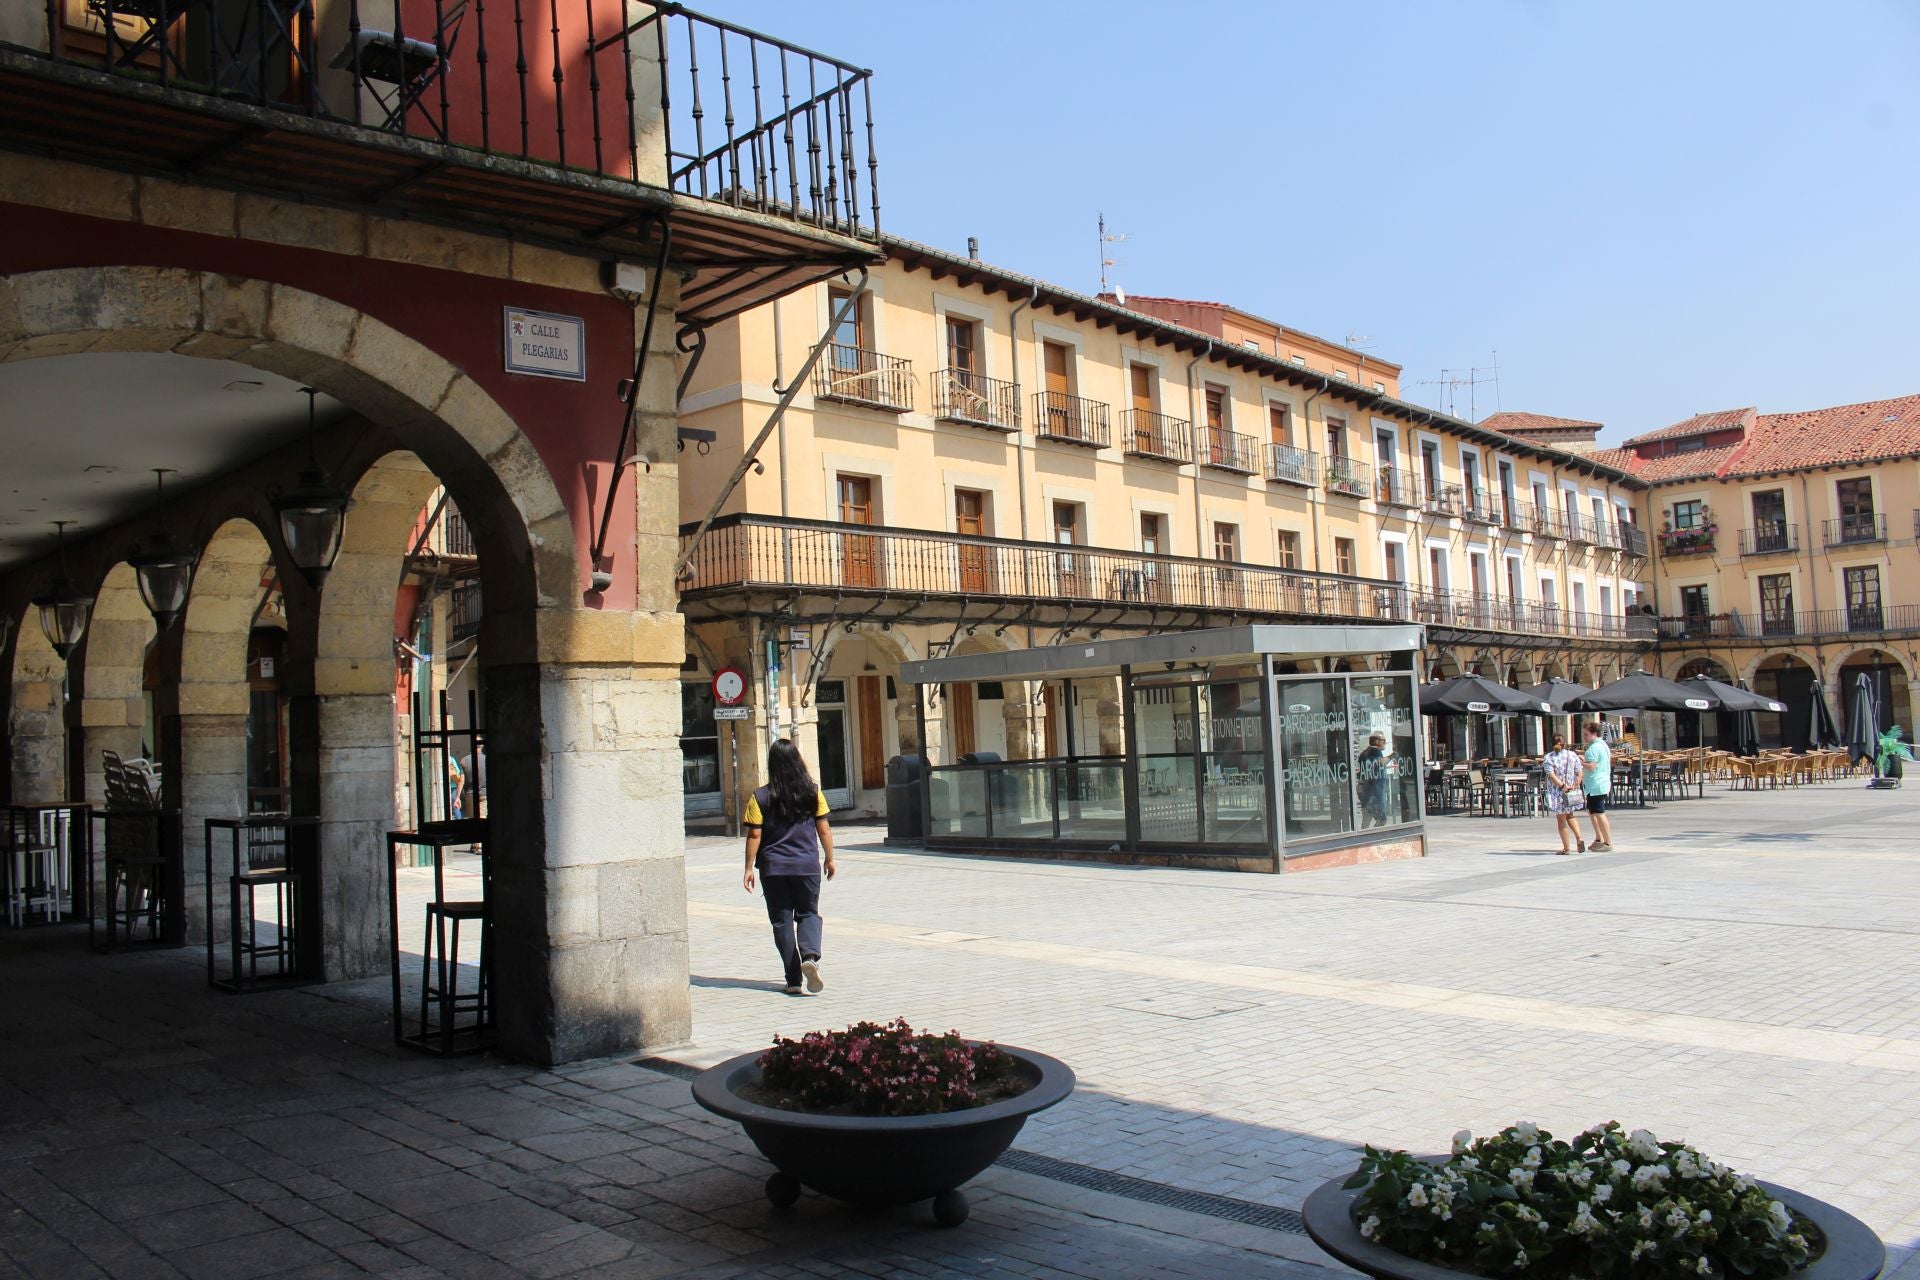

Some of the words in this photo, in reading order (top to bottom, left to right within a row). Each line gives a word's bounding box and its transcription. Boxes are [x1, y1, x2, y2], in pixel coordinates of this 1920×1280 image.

[530, 324, 560, 339] CALLE
[522, 343, 569, 361] PLEGARIAS
[1283, 761, 1349, 790] PARKING
